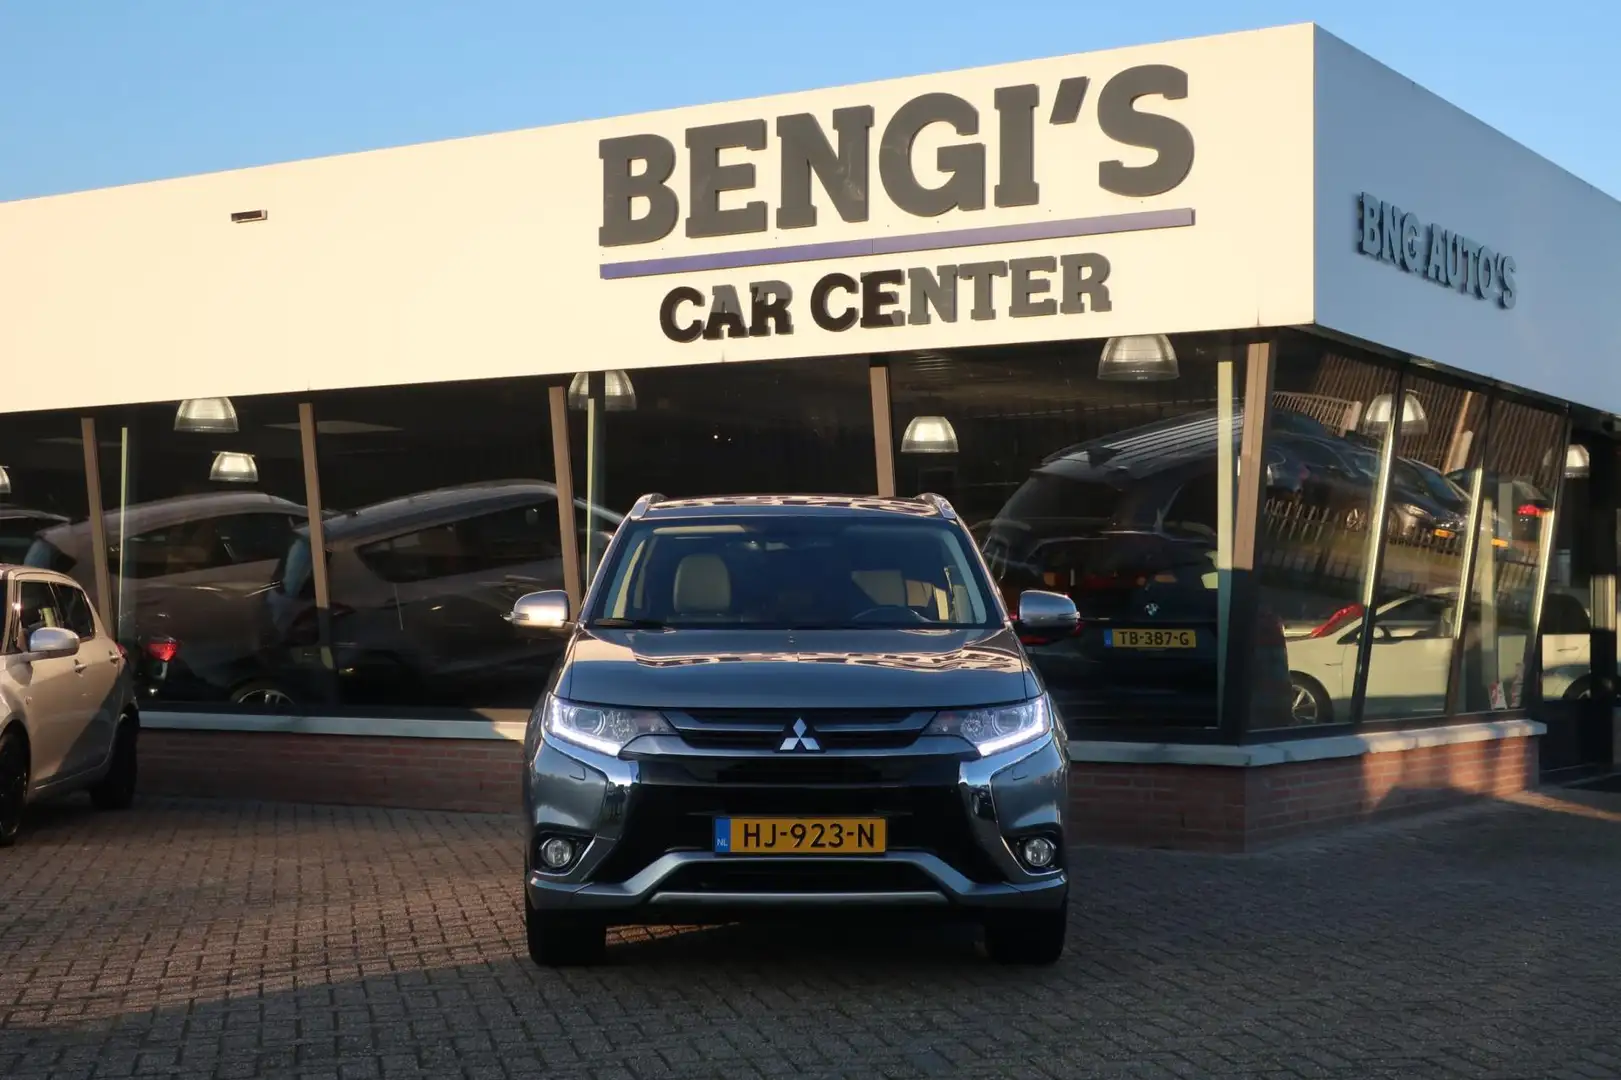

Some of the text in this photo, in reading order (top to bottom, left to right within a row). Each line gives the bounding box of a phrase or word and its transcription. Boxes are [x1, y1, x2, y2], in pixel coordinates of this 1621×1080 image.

[598, 64, 1195, 248] BENGI'S
[1356, 191, 1518, 309] BNG AUTO'S
[660, 252, 1113, 343] CAR CENTER
[1119, 631, 1189, 646] TB-387-G
[716, 823, 875, 848] NL HJ-923-N
